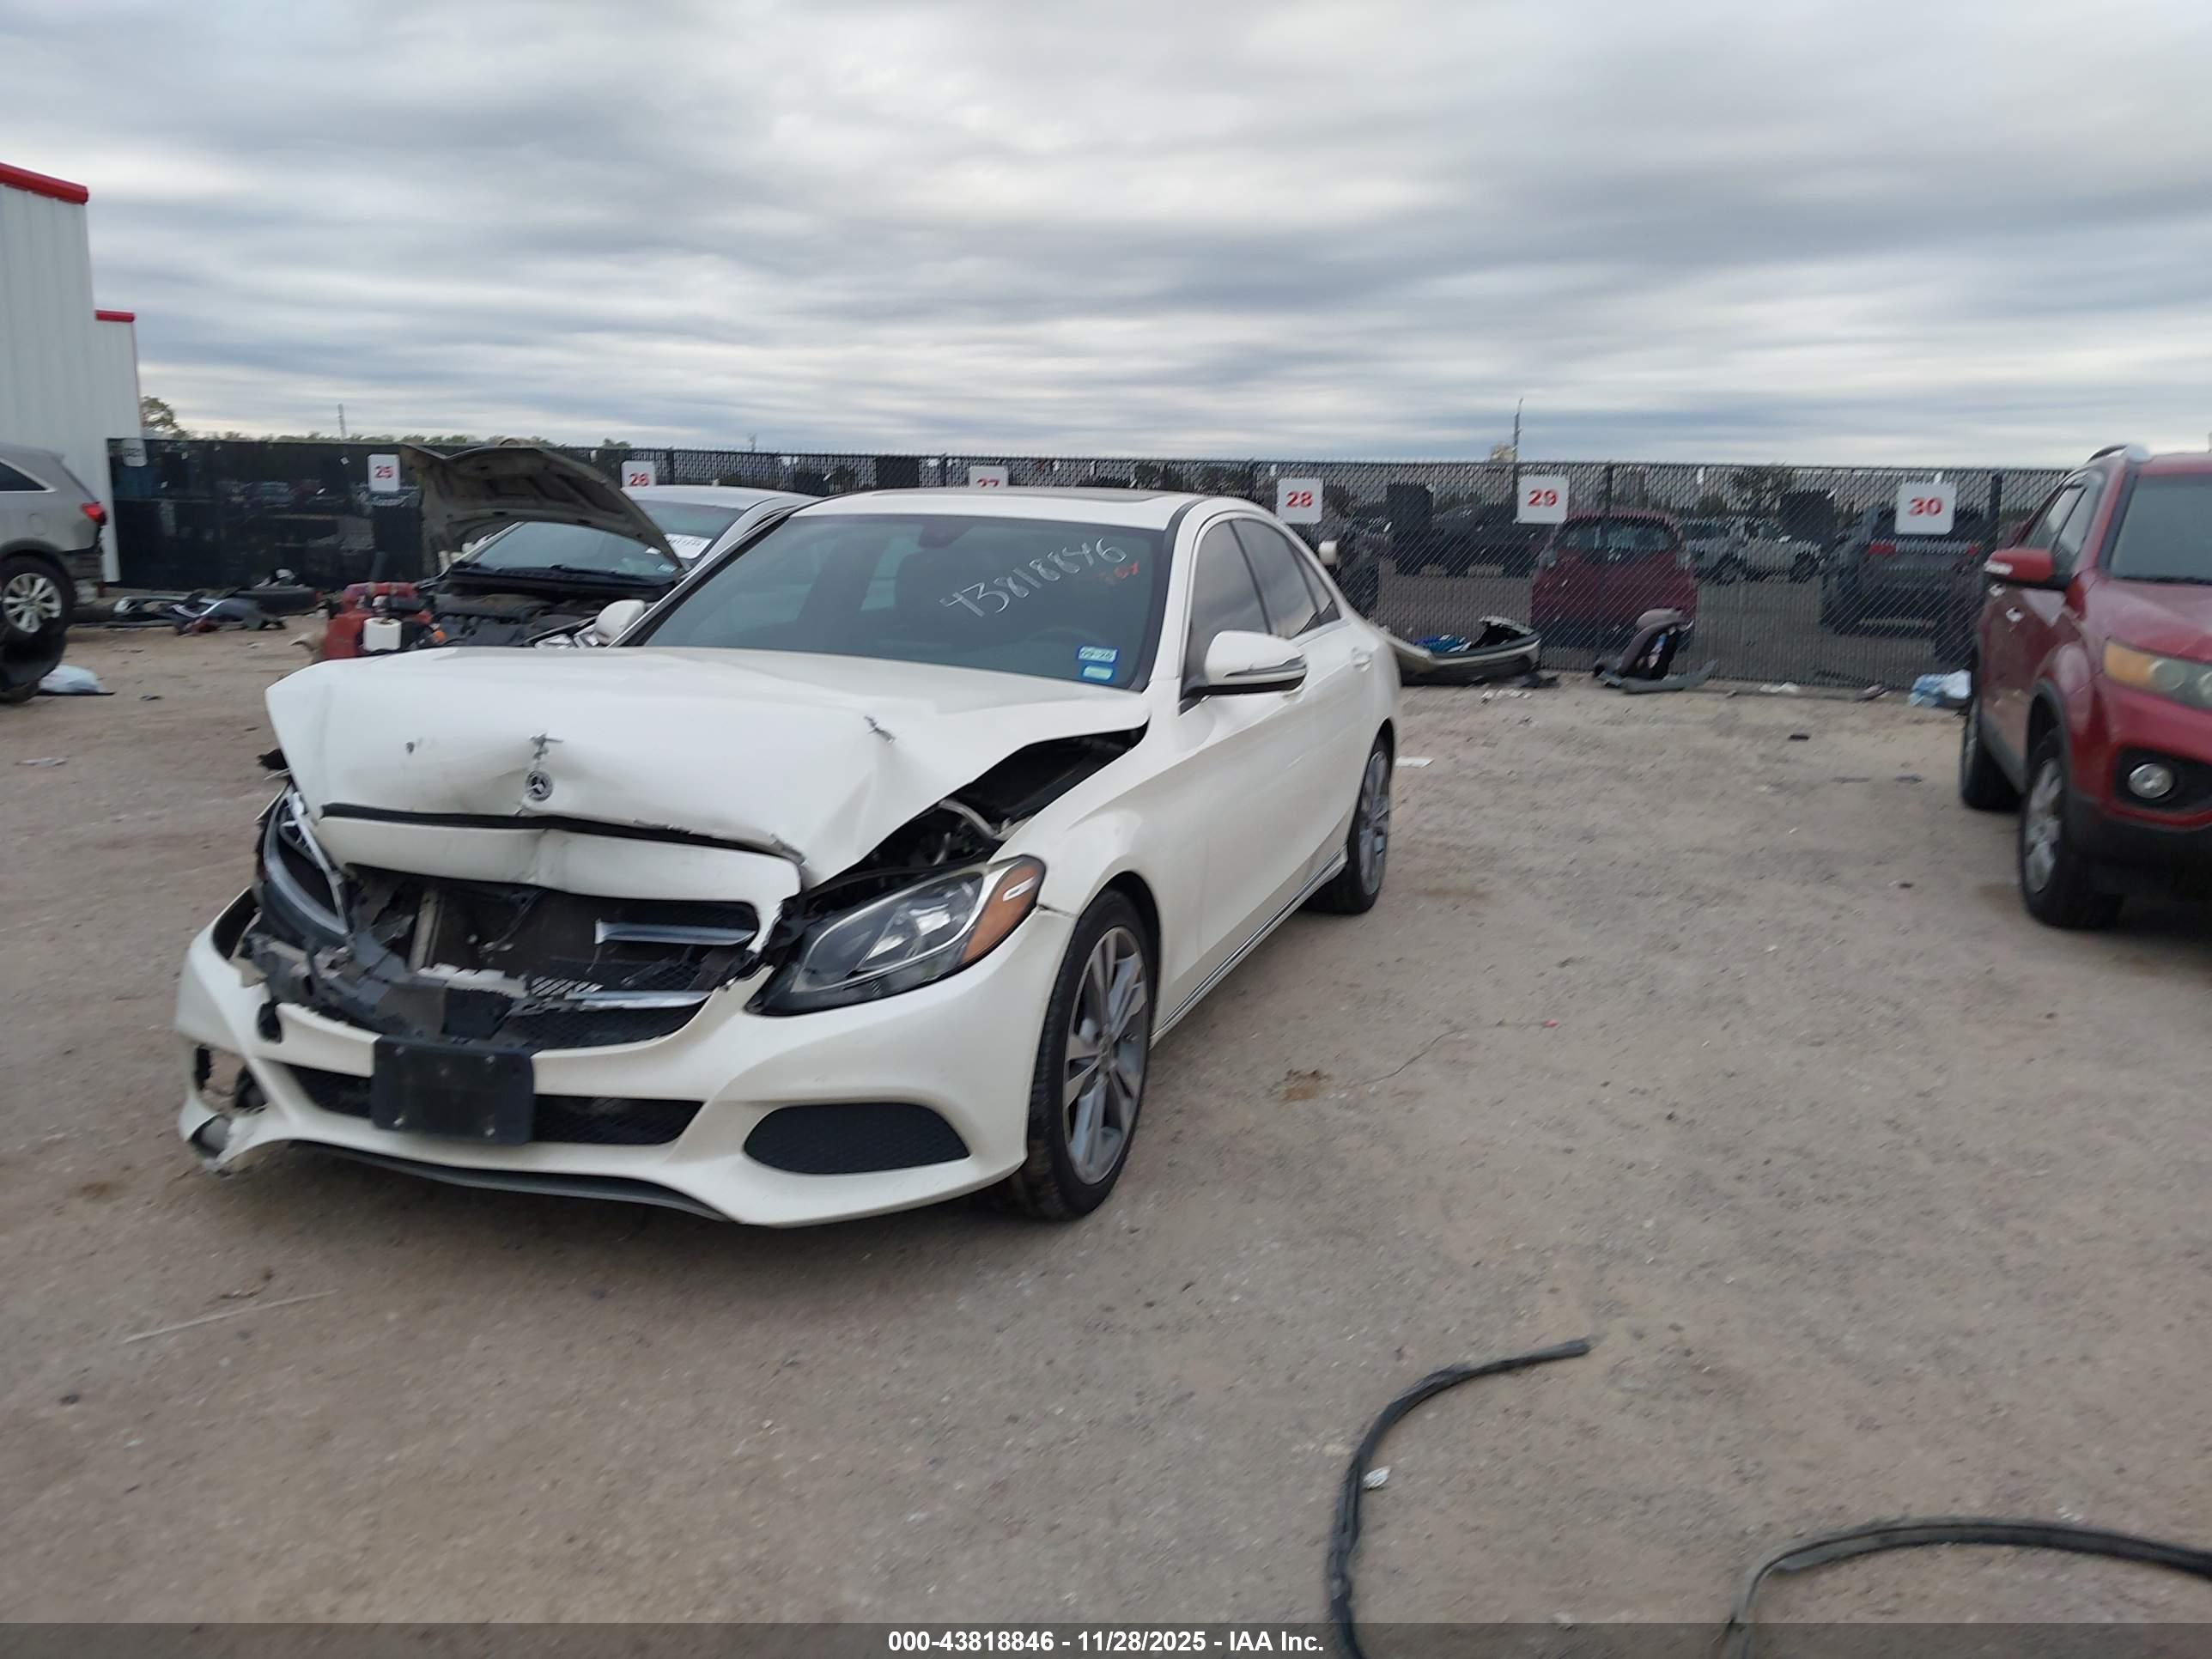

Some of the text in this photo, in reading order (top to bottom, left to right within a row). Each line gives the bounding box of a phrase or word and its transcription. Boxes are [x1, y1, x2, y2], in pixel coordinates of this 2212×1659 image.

[374, 465, 393, 478] 25
[629, 472, 649, 487] 26
[1285, 490, 1313, 508] 28
[1528, 489, 1558, 507] 29
[1908, 497, 1943, 517] 30
[939, 537, 1127, 618] 43818846
